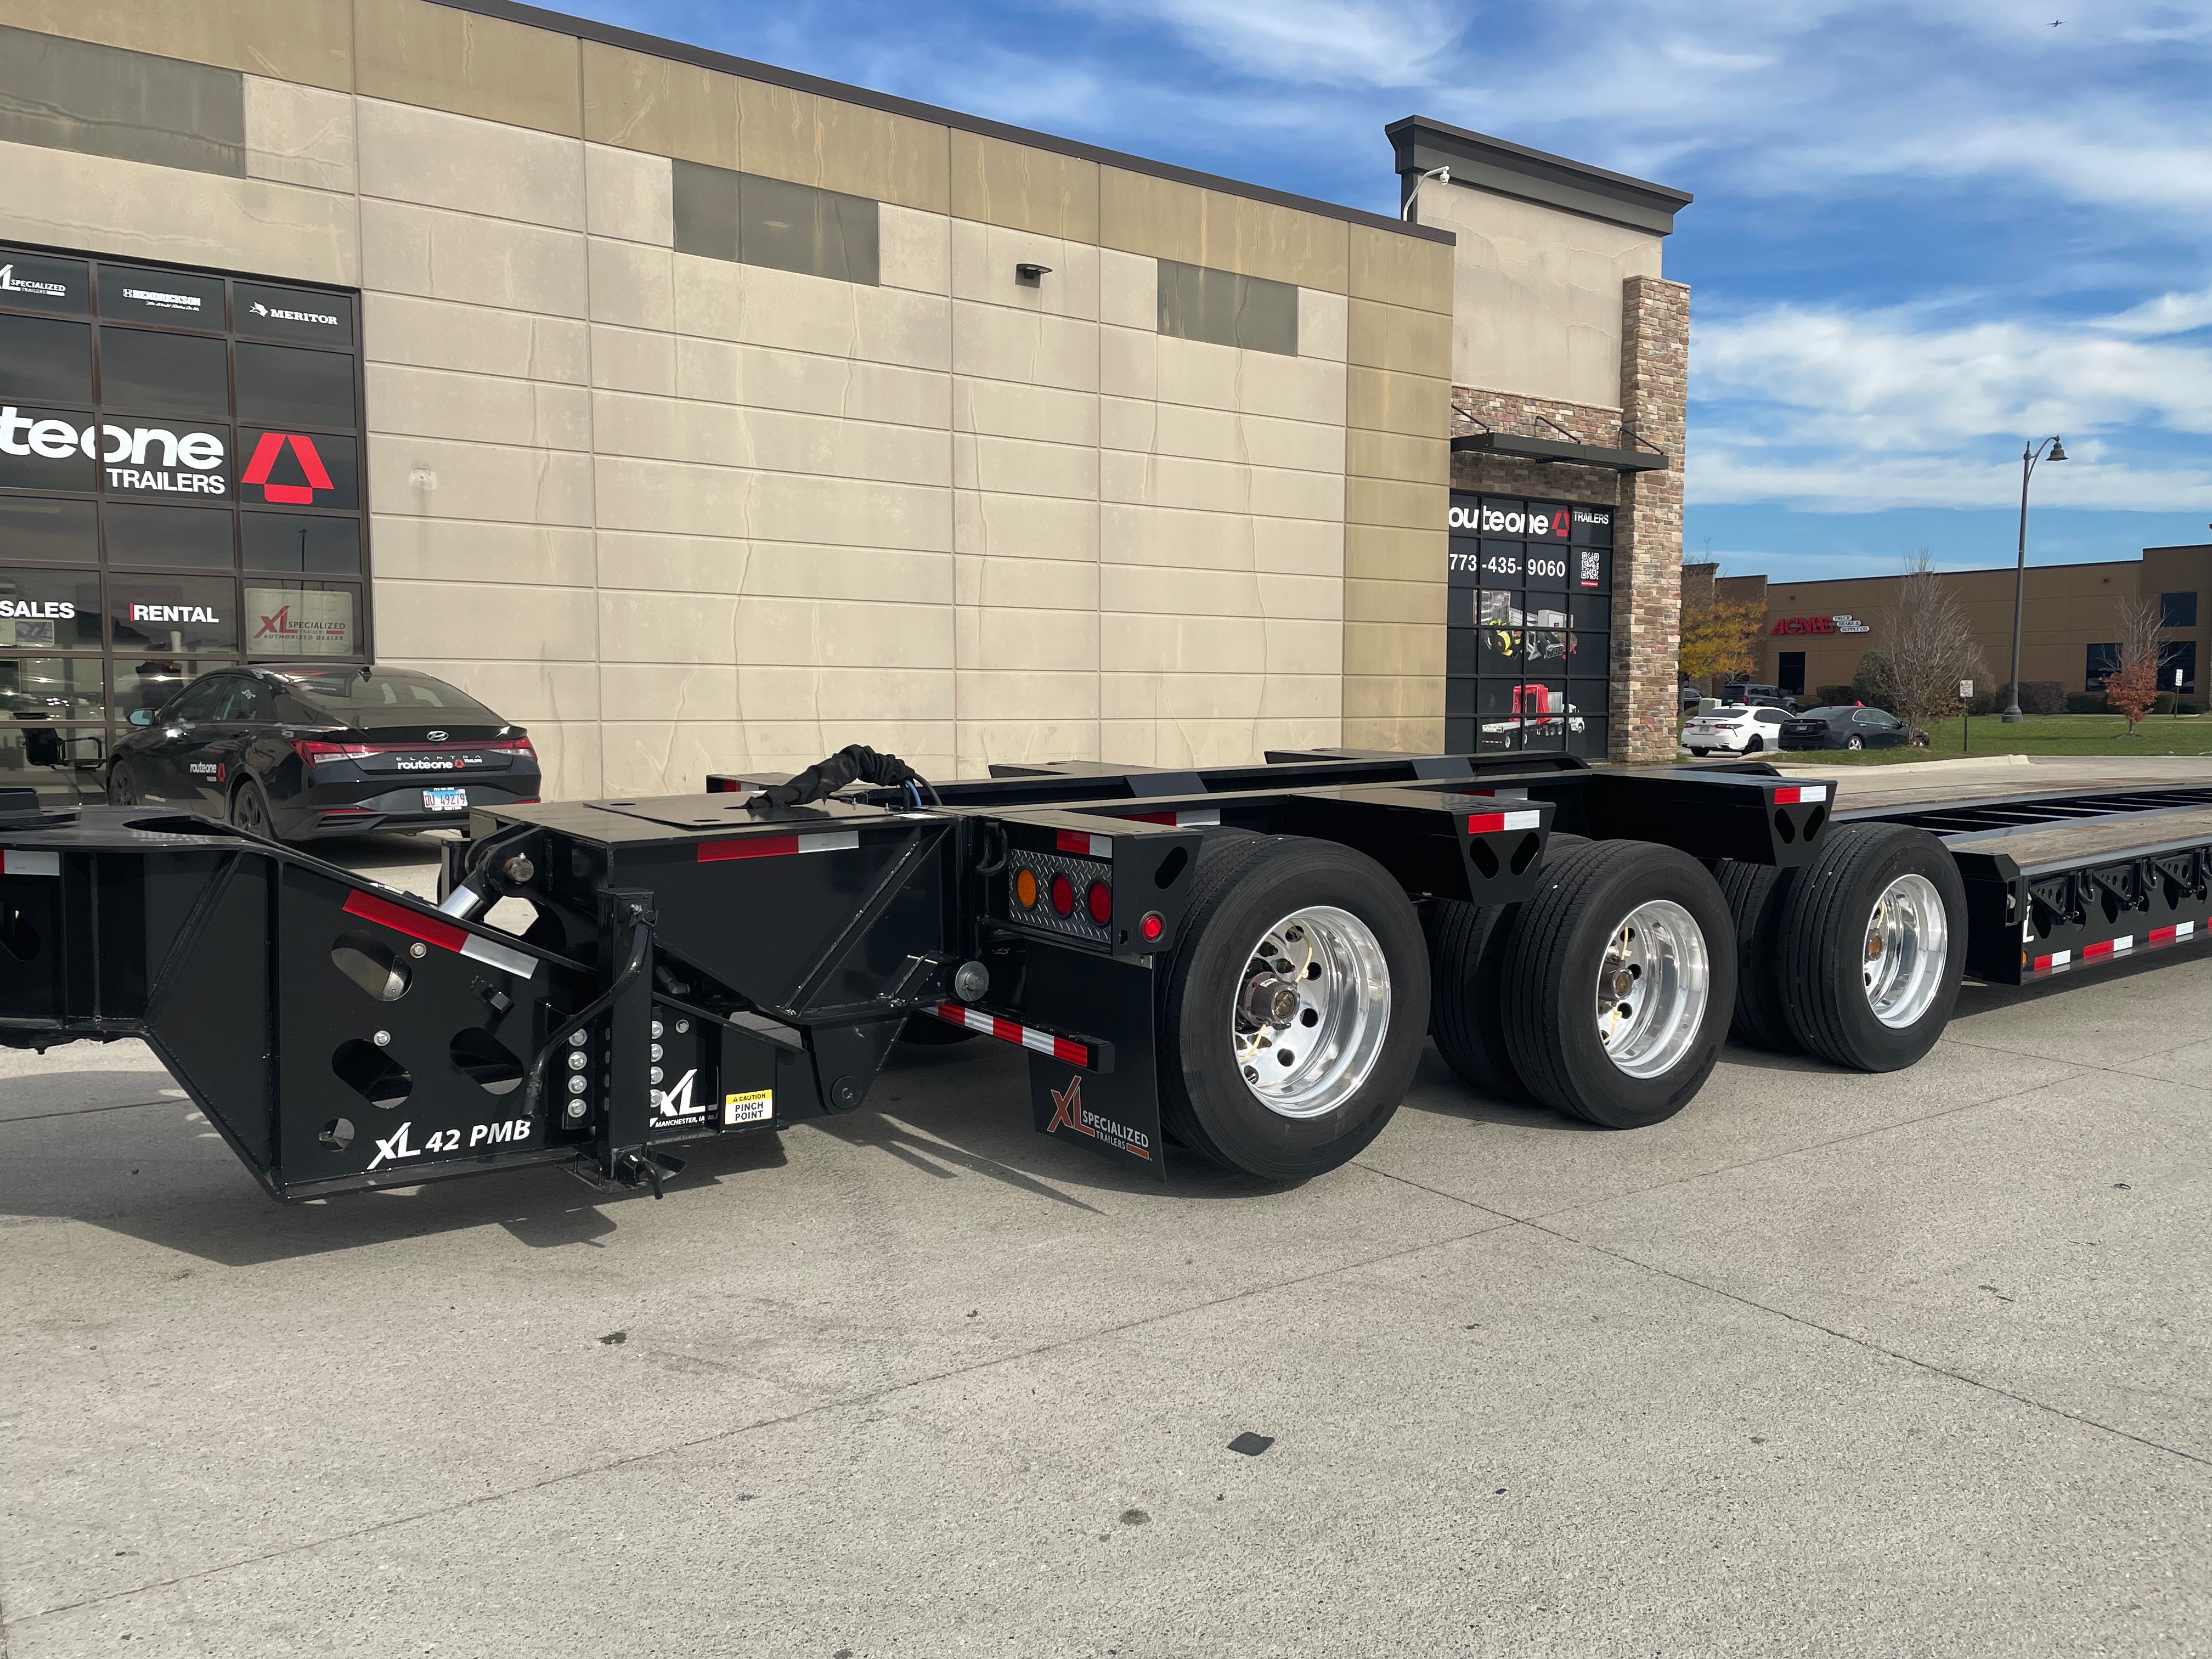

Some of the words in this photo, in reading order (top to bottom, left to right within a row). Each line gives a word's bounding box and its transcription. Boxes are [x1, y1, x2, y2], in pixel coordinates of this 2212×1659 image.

[10, 279, 66, 292] SPECIALIZED
[133, 290, 201, 306] HENDRICKSON
[270, 308, 338, 325] MERITOR
[106, 468, 225, 494] TRAILERS
[1449, 505, 1549, 535] outeone
[1573, 511, 1609, 525] TRAILERS
[0, 601, 75, 619] SALES
[133, 605, 219, 623] RENTAL
[253, 605, 298, 639] XL
[288, 621, 346, 630] SPECIALIZED
[1770, 617, 1835, 635] ACME
[190, 761, 217, 774] routeone
[398, 760, 453, 770] routeone
[425, 794, 435, 806] DU
[441, 793, 465, 805] 49279
[739, 1093, 766, 1102] CAUTION
[1047, 1075, 1096, 1137] XL
[735, 1102, 764, 1113] PINCH
[735, 1110, 763, 1121] POINT
[1082, 1110, 1149, 1148] SPECIALIZED
[366, 1122, 421, 1170] XL
[425, 1129, 460, 1153] 42
[470, 1119, 531, 1147] PMB
[1096, 1130, 1125, 1150] TRAILERS
